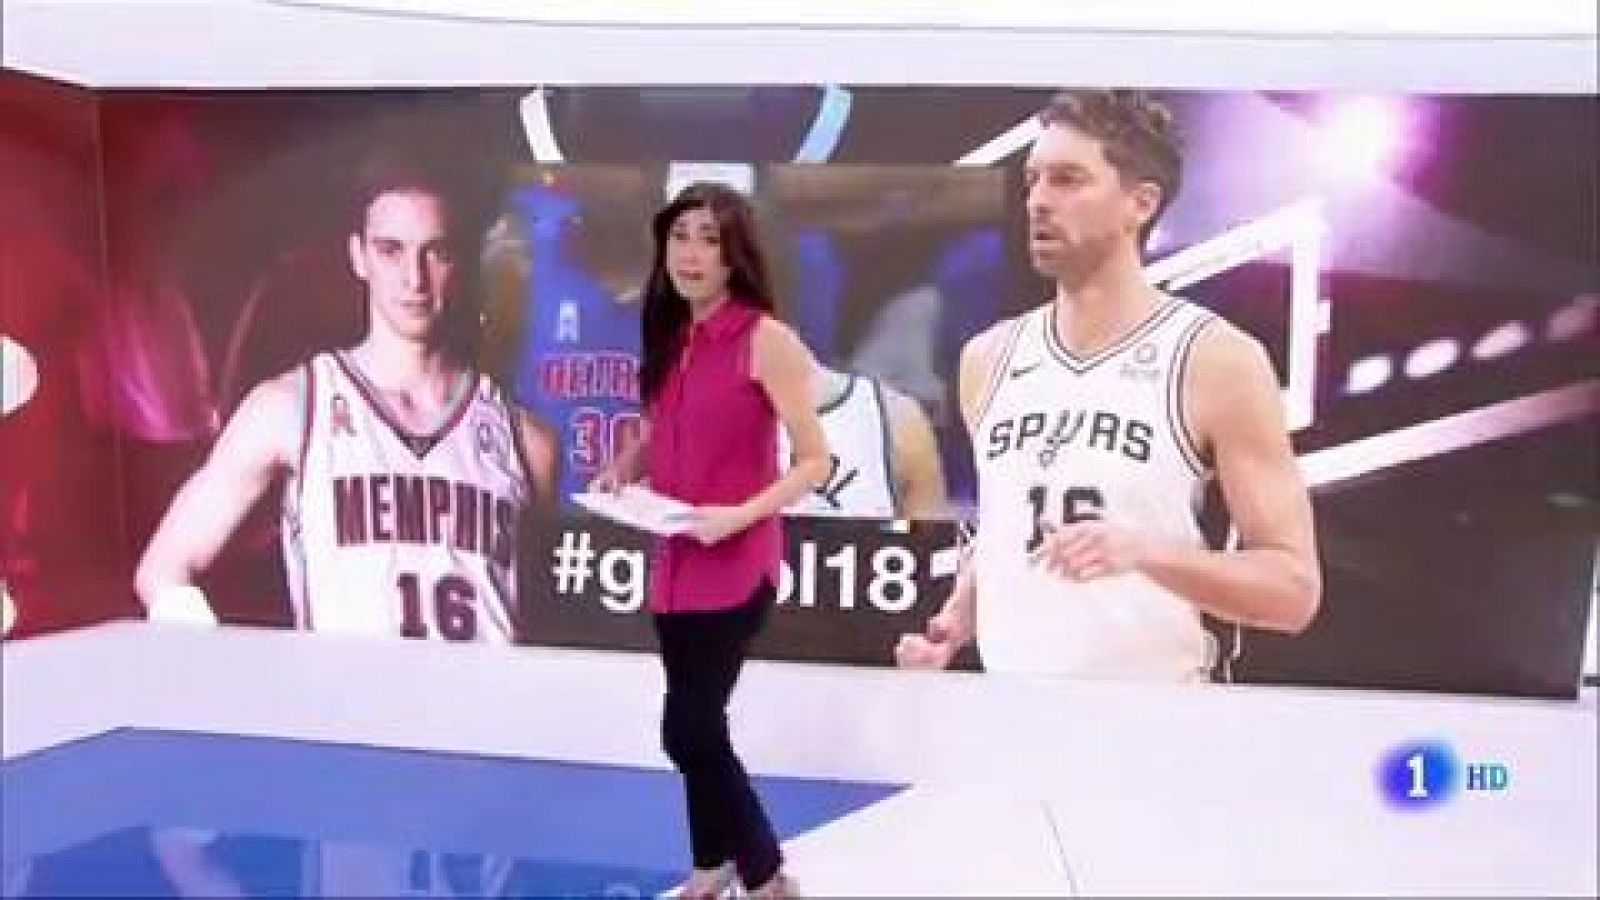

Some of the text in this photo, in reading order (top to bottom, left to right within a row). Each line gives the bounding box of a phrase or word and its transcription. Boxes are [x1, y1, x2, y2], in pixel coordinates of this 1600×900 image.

[986, 409, 1153, 467] SPURS
[333, 473, 515, 568] MEMPHIS
[396, 572, 478, 642] 16
